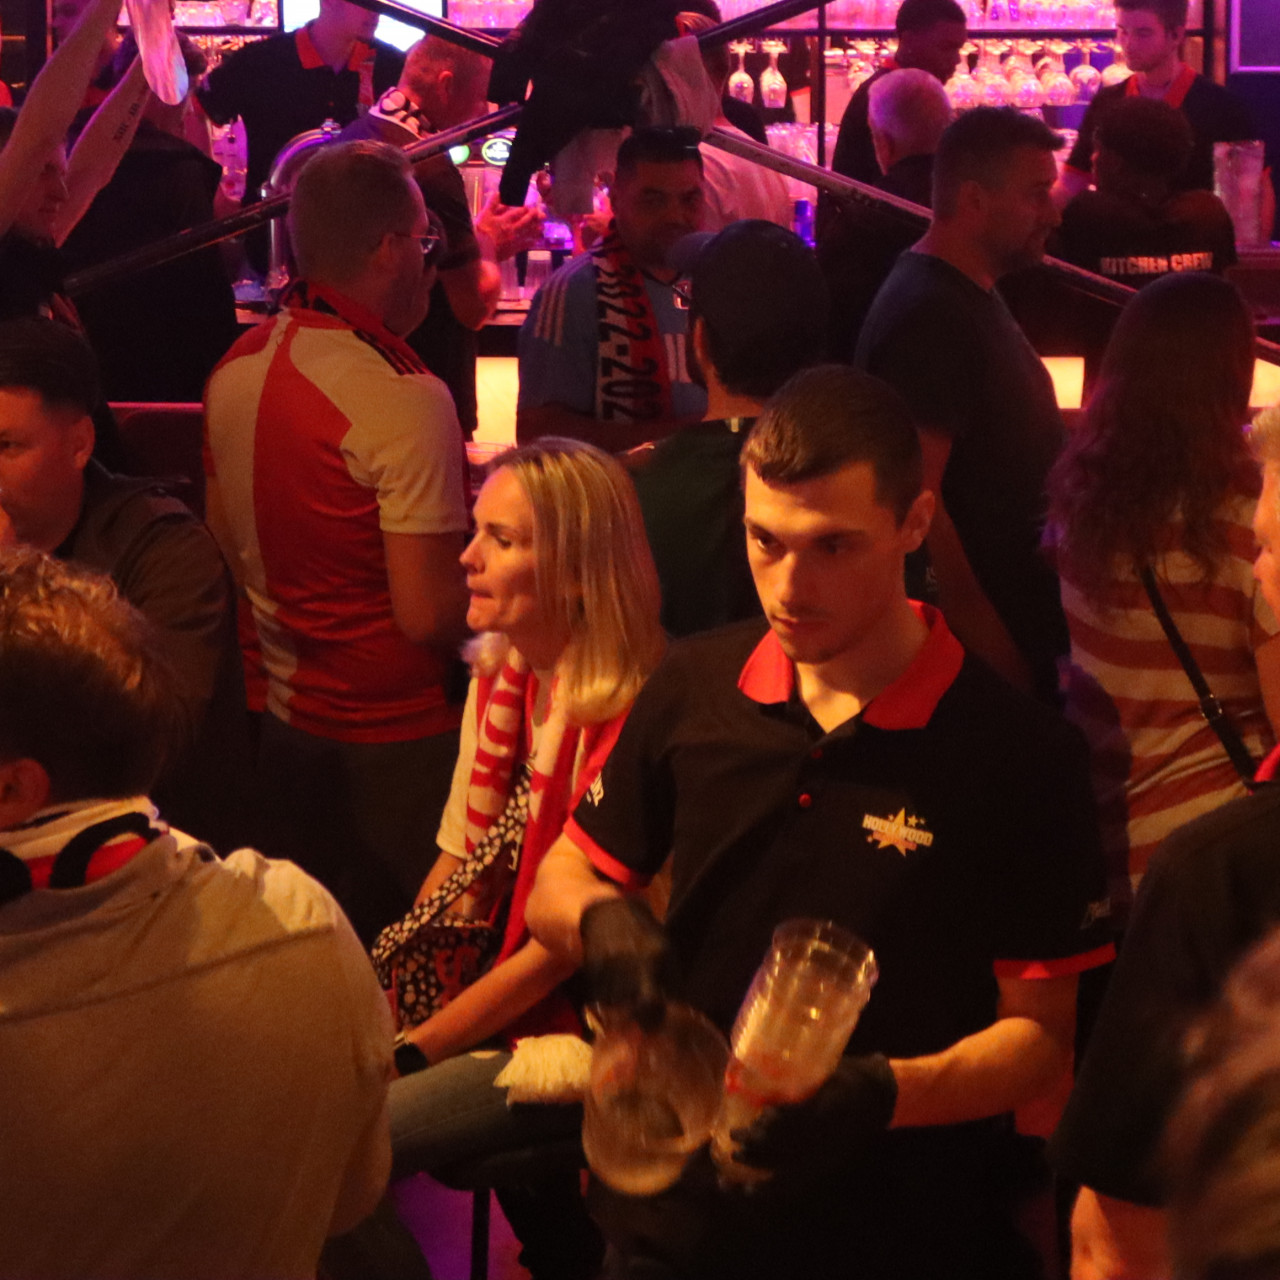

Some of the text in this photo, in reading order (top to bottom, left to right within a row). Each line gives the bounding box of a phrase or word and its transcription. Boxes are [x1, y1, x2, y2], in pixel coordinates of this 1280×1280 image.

[1101, 252, 1213, 275] KITCHEN CREW
[596, 262, 664, 422] 2022-202
[862, 814, 934, 847] HOLLYWOOD
